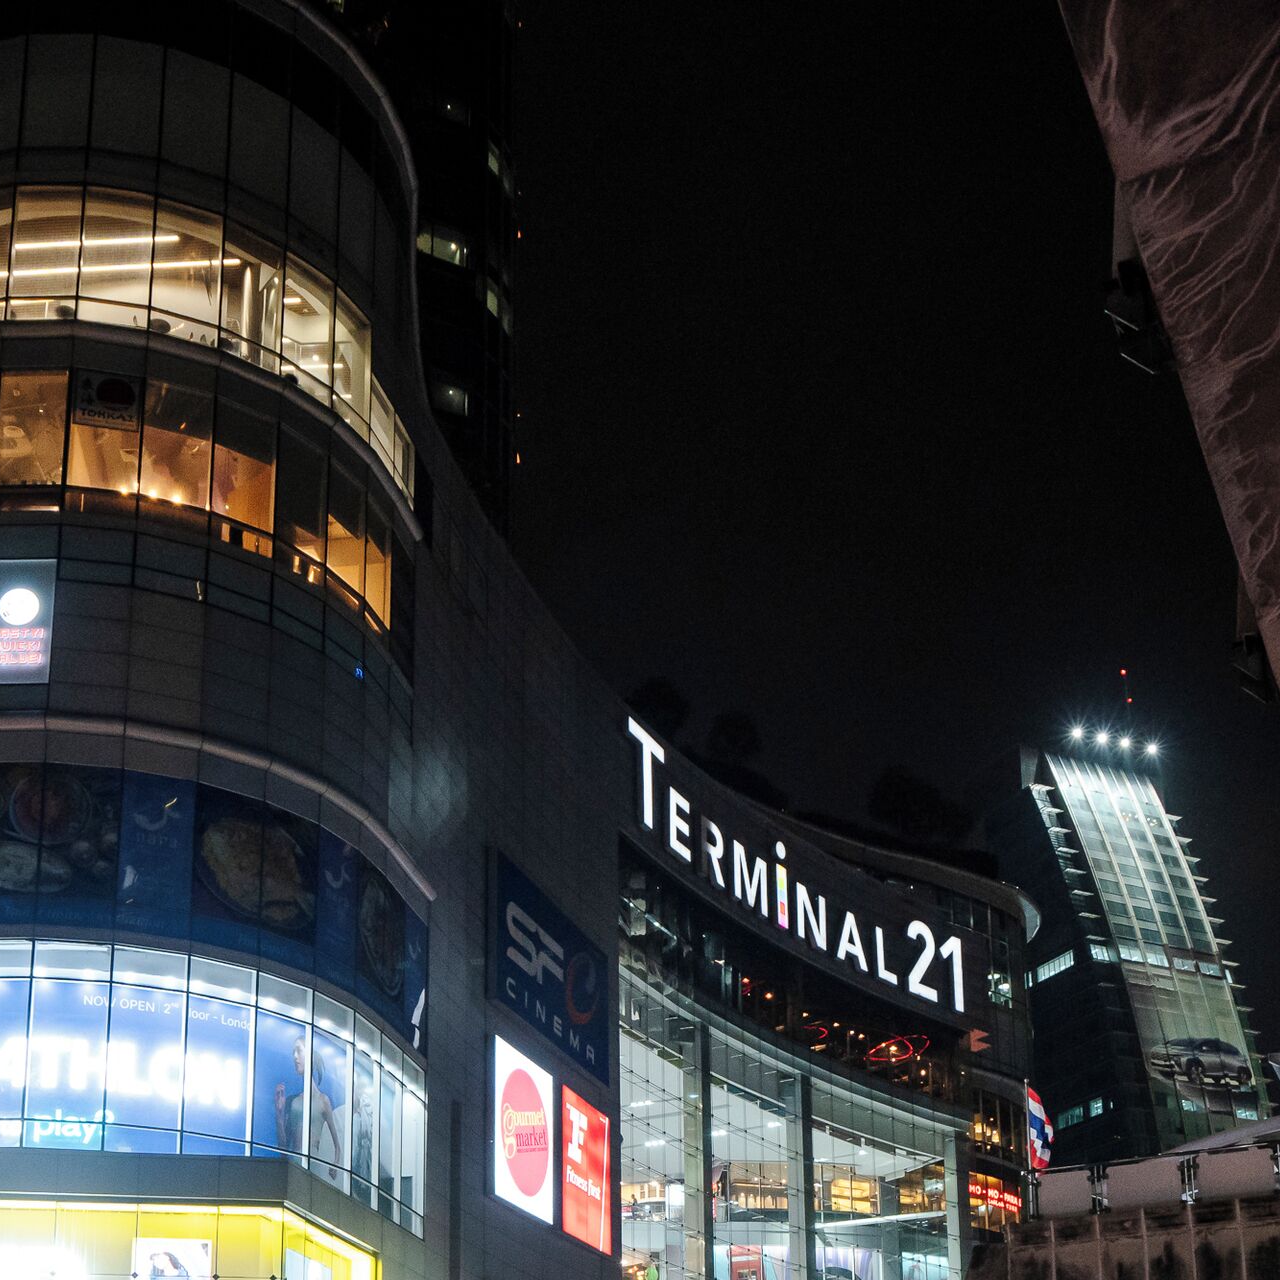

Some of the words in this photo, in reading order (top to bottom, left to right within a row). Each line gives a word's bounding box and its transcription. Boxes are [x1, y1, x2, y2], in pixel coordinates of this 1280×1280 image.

[506, 901, 564, 984] SF
[907, 920, 964, 1013] 21
[83, 994, 115, 1008] NOW
[120, 999, 155, 1013] OPEN
[188, 1010, 211, 1021] loor
[506, 977, 595, 1065] CINEMA
[504, 1102, 546, 1160] gourmet
[516, 1126, 548, 1148] market
